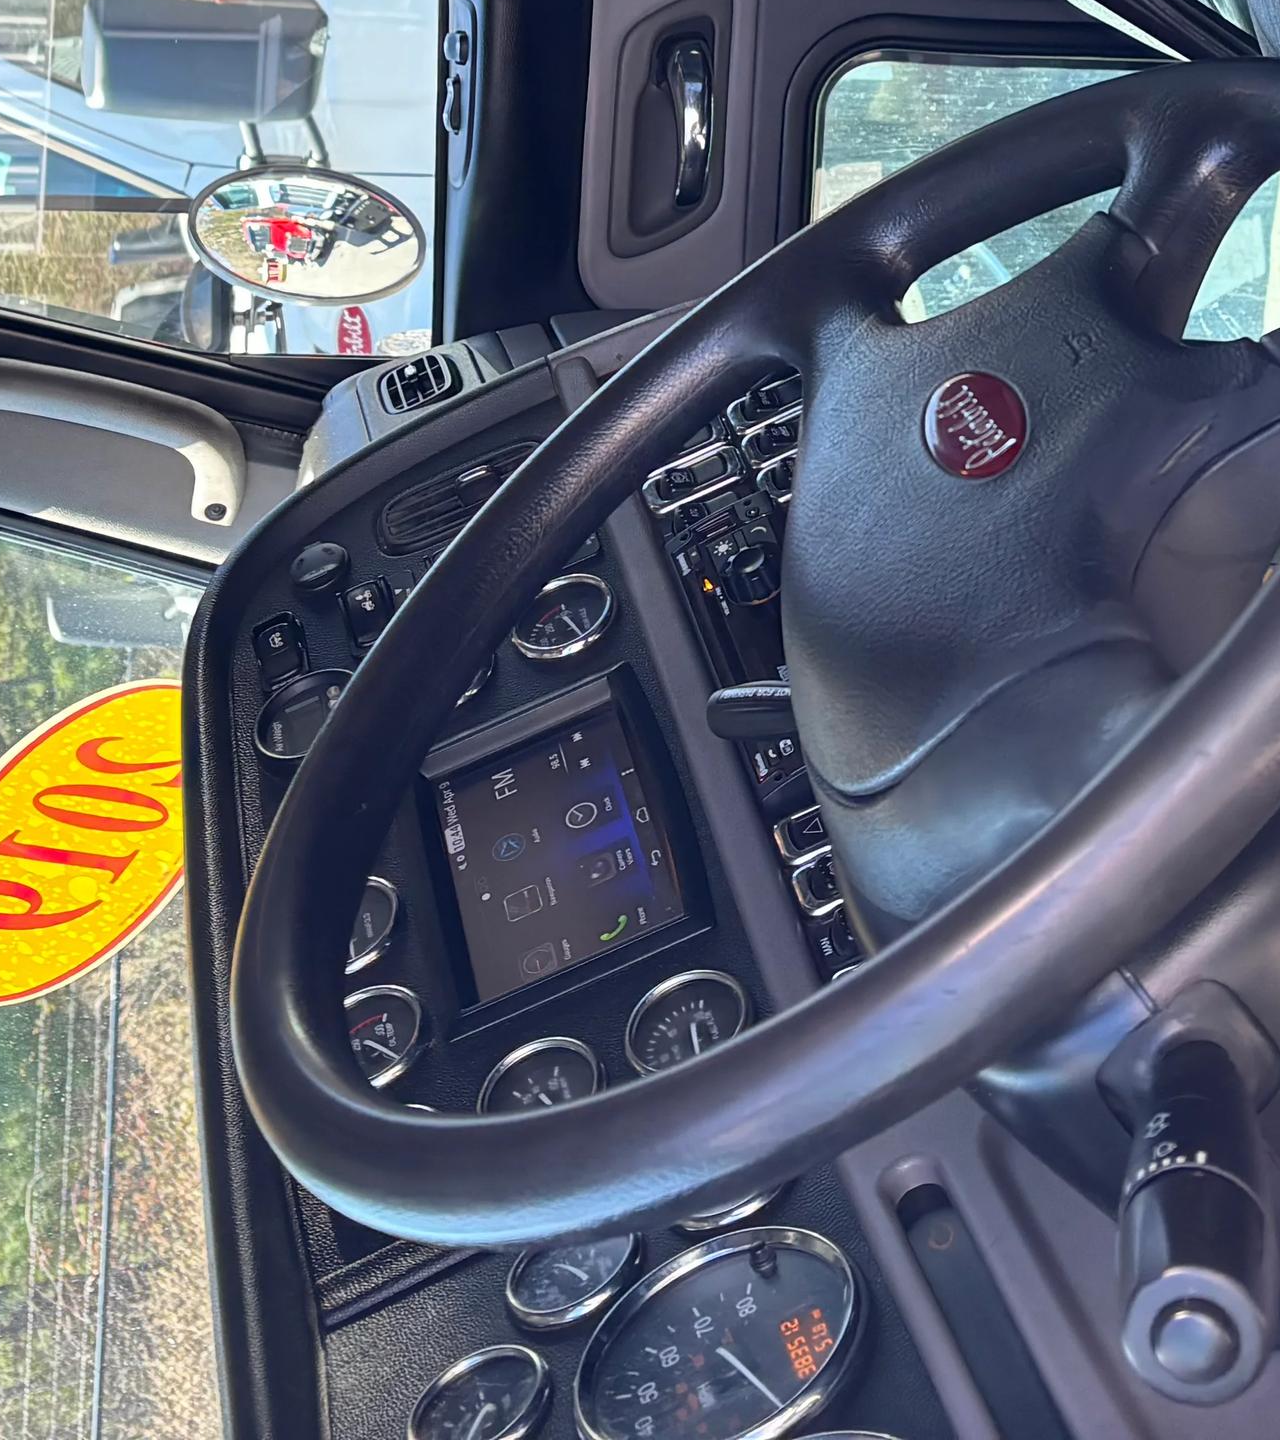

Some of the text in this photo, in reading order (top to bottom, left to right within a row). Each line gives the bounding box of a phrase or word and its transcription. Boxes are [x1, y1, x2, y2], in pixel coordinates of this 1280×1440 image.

[342, 309, 364, 354] rbilt
[936, 384, 1017, 470] Peterbilt
[548, 753, 560, 770] 98.5
[438, 780, 450, 789] 9
[491, 767, 518, 800] FM
[441, 789, 454, 804] Apr
[443, 804, 459, 826] Wed
[635, 906, 648, 925] Phone
[820, 937, 833, 956] MAN
[736, 1296, 757, 1318] 80
[693, 1316, 714, 1338] 70
[659, 1345, 680, 1368] 60
[638, 1381, 659, 1404] 50
[634, 1415, 654, 1436] 40
